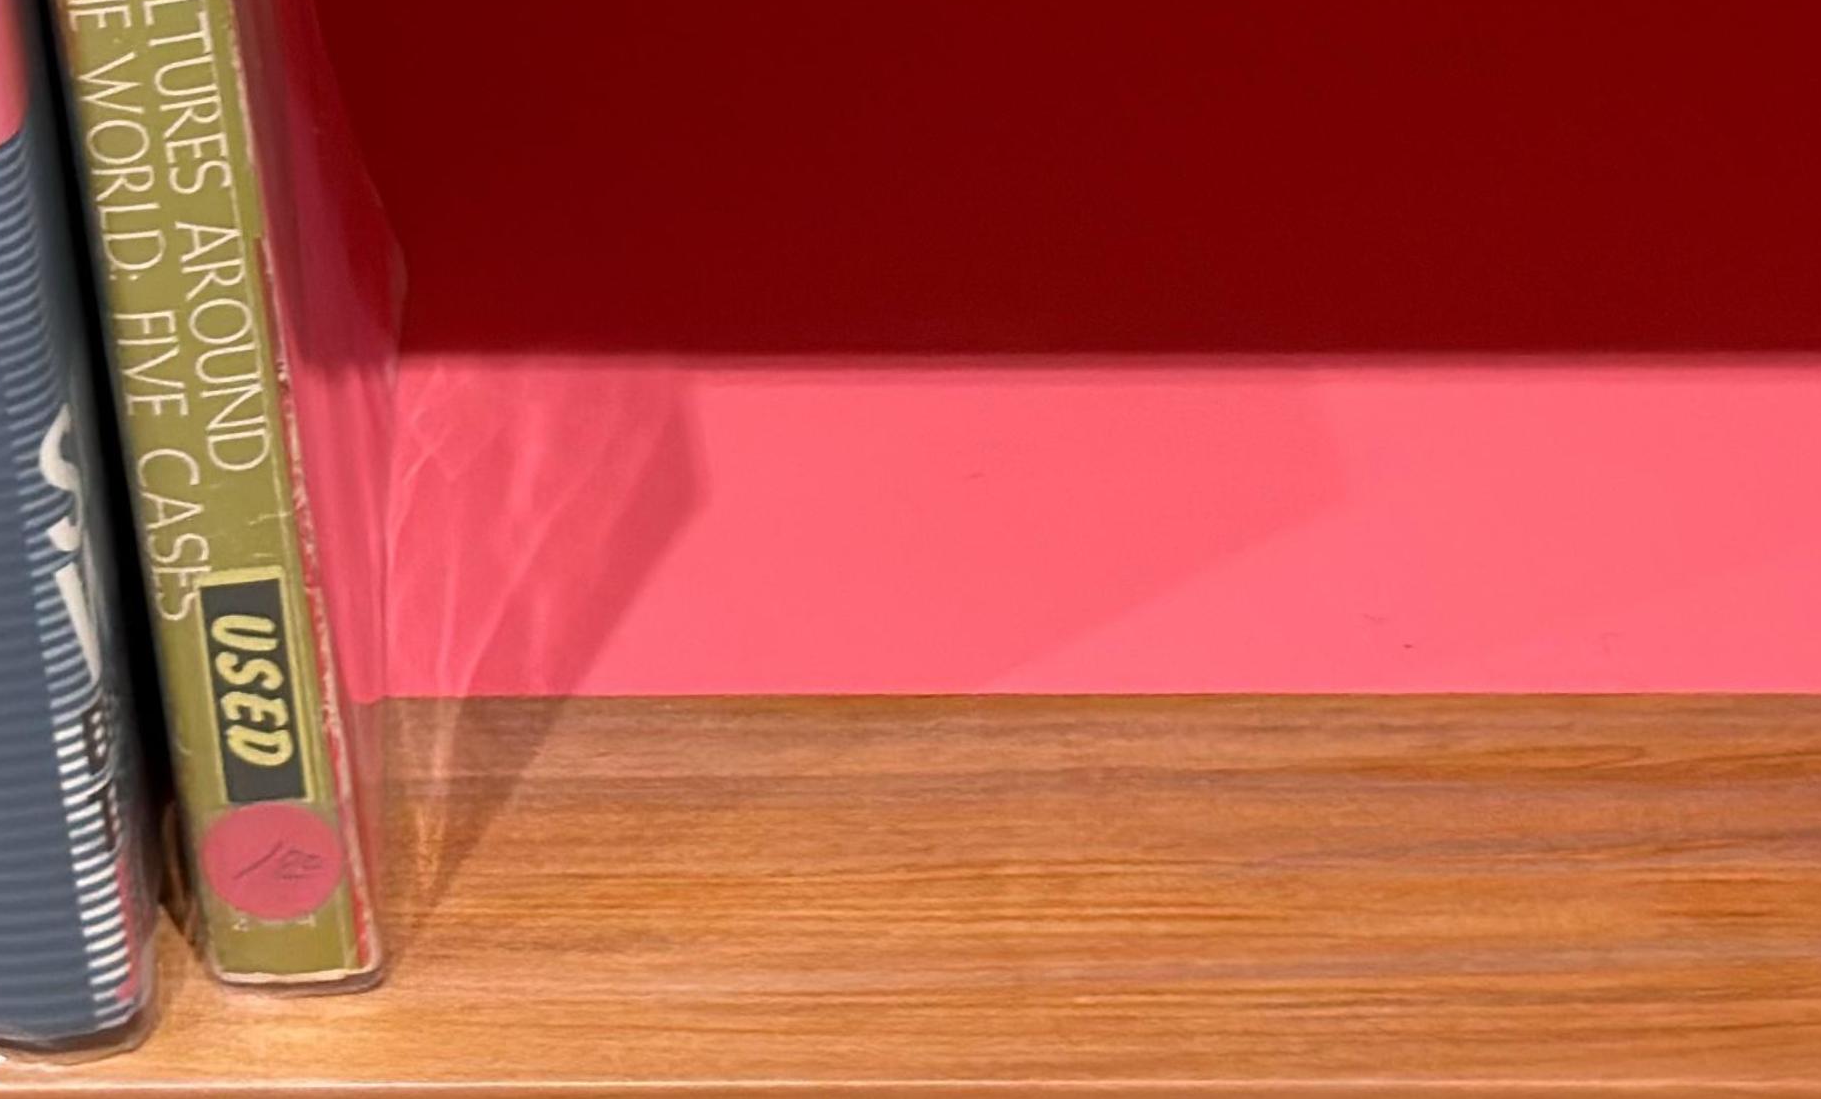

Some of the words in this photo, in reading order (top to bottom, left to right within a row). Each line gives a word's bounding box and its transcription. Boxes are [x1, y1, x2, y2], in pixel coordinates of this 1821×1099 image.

[111, 309, 190, 417] FIVE
[174, 220, 272, 472] AROUND
[136, 447, 213, 623] CASES
[210, 612, 295, 768] USED
